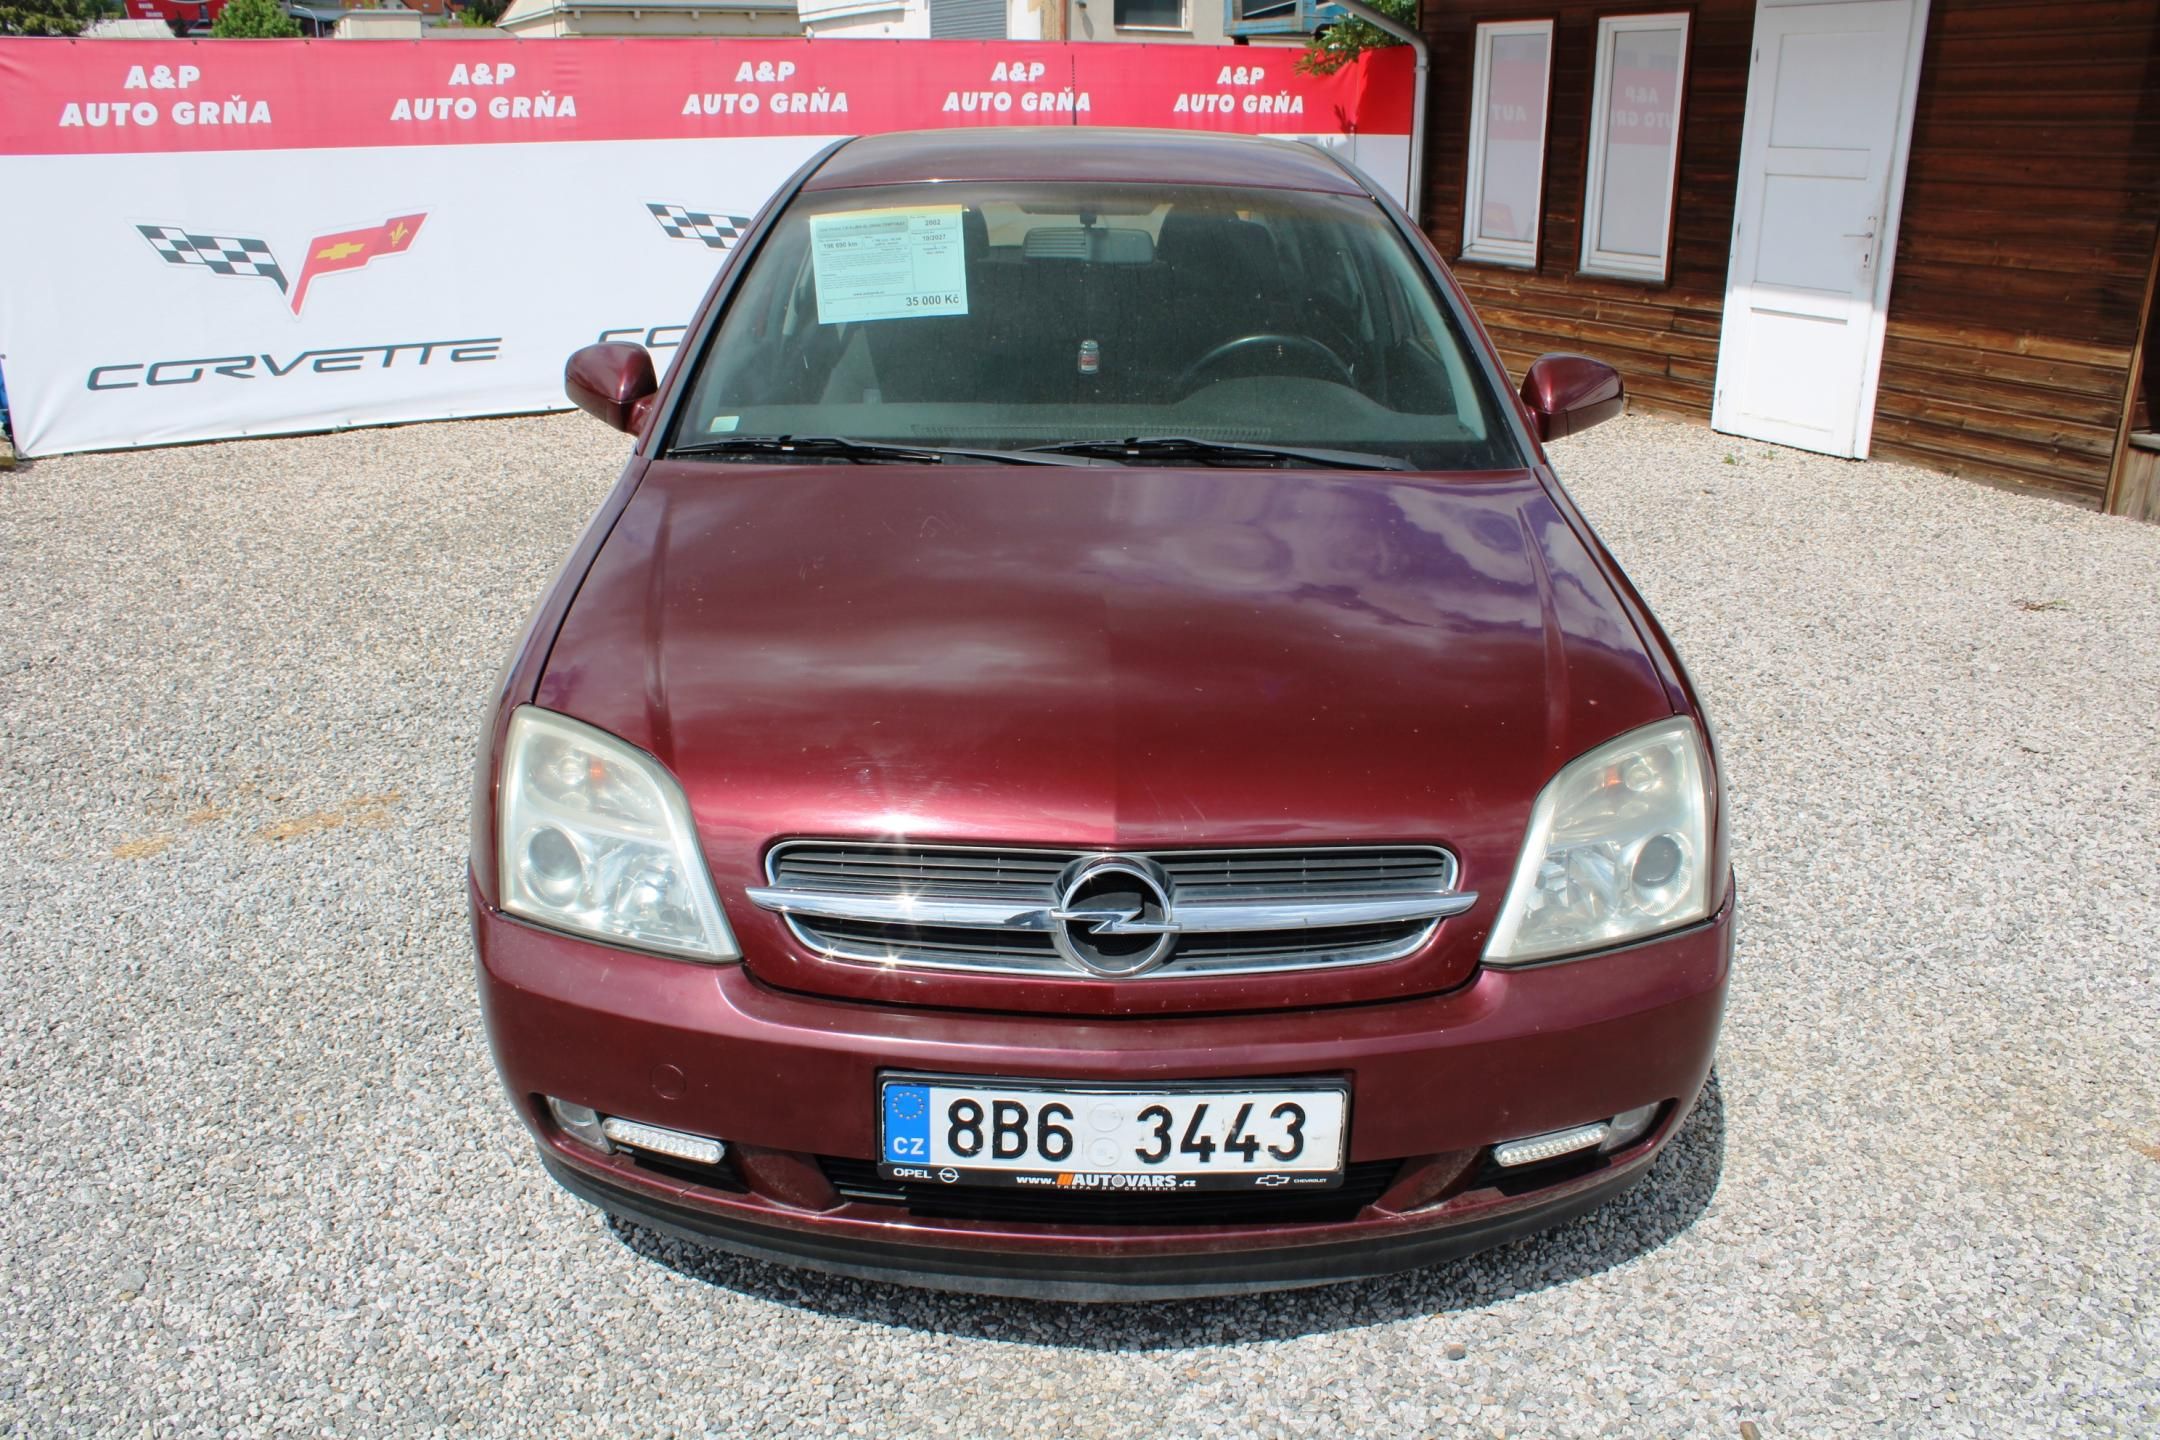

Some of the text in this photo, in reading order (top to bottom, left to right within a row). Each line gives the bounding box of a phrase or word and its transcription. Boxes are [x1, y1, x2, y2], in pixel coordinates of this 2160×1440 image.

[124, 65, 201, 89] A&P
[448, 63, 517, 86] A&P
[735, 61, 796, 83] A&P
[990, 62, 1045, 82] A&P
[1216, 66, 1265, 85] A&P
[390, 90, 577, 121] AUTO GRŇA
[681, 86, 848, 115] AUTO GRŇA
[942, 86, 1091, 111] AUTO GRŇA
[1173, 90, 1303, 113] AUTO GRŇA
[59, 94, 272, 127] AUTO GRŇA
[906, 294, 959, 306] 35 000 Kč
[87, 337, 502, 391] CORVETTE
[947, 1098, 1306, 1164] 8B6 3443
[893, 1137, 925, 1155] CZ
[893, 1167, 932, 1179] OPEL
